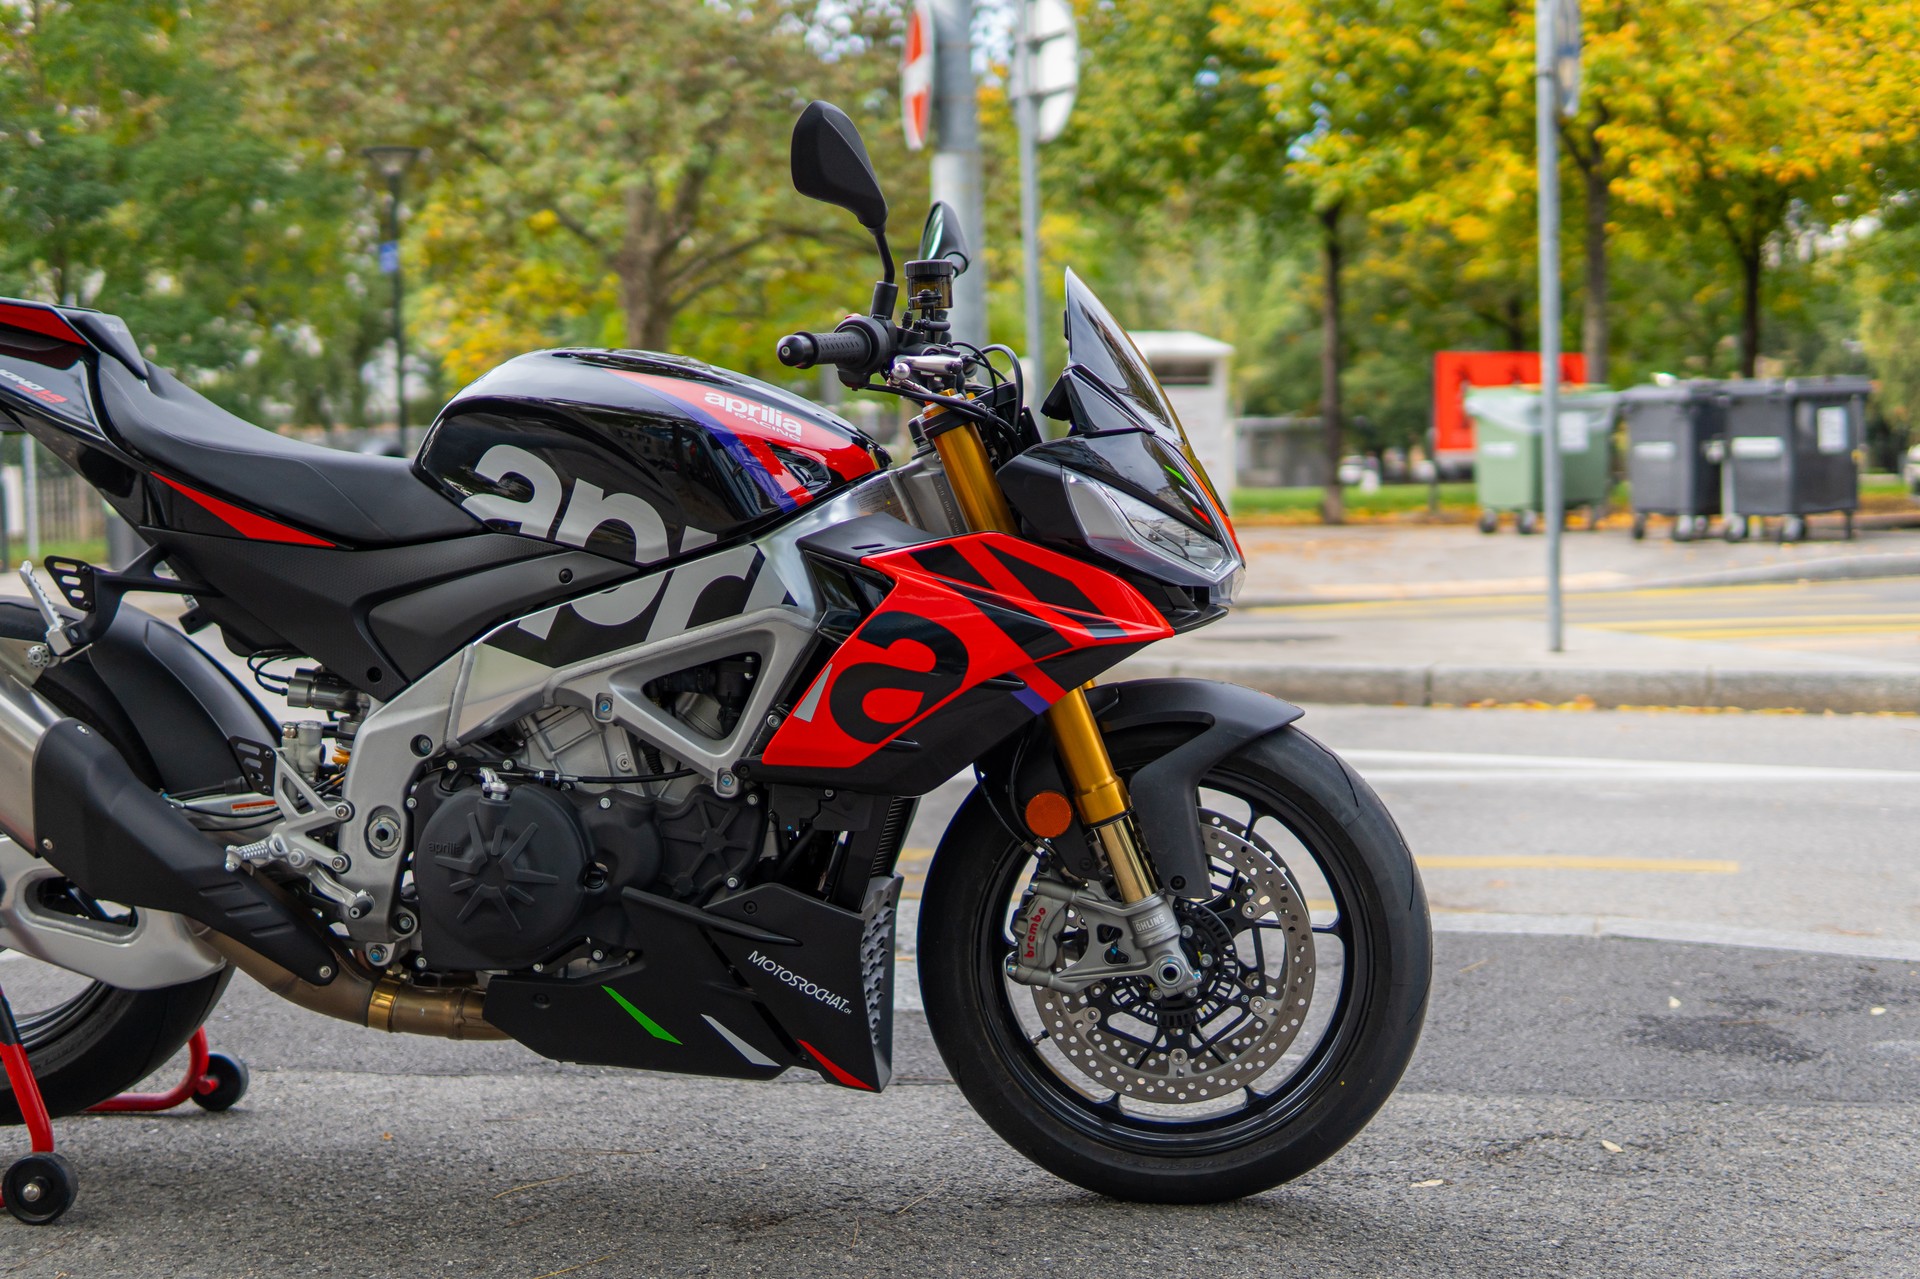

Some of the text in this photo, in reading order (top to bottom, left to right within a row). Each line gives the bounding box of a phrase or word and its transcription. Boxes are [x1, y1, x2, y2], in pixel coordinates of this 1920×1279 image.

[704, 392, 802, 437] aprilia
[734, 412, 801, 442] RACING
[1024, 907, 1046, 959] brembo
